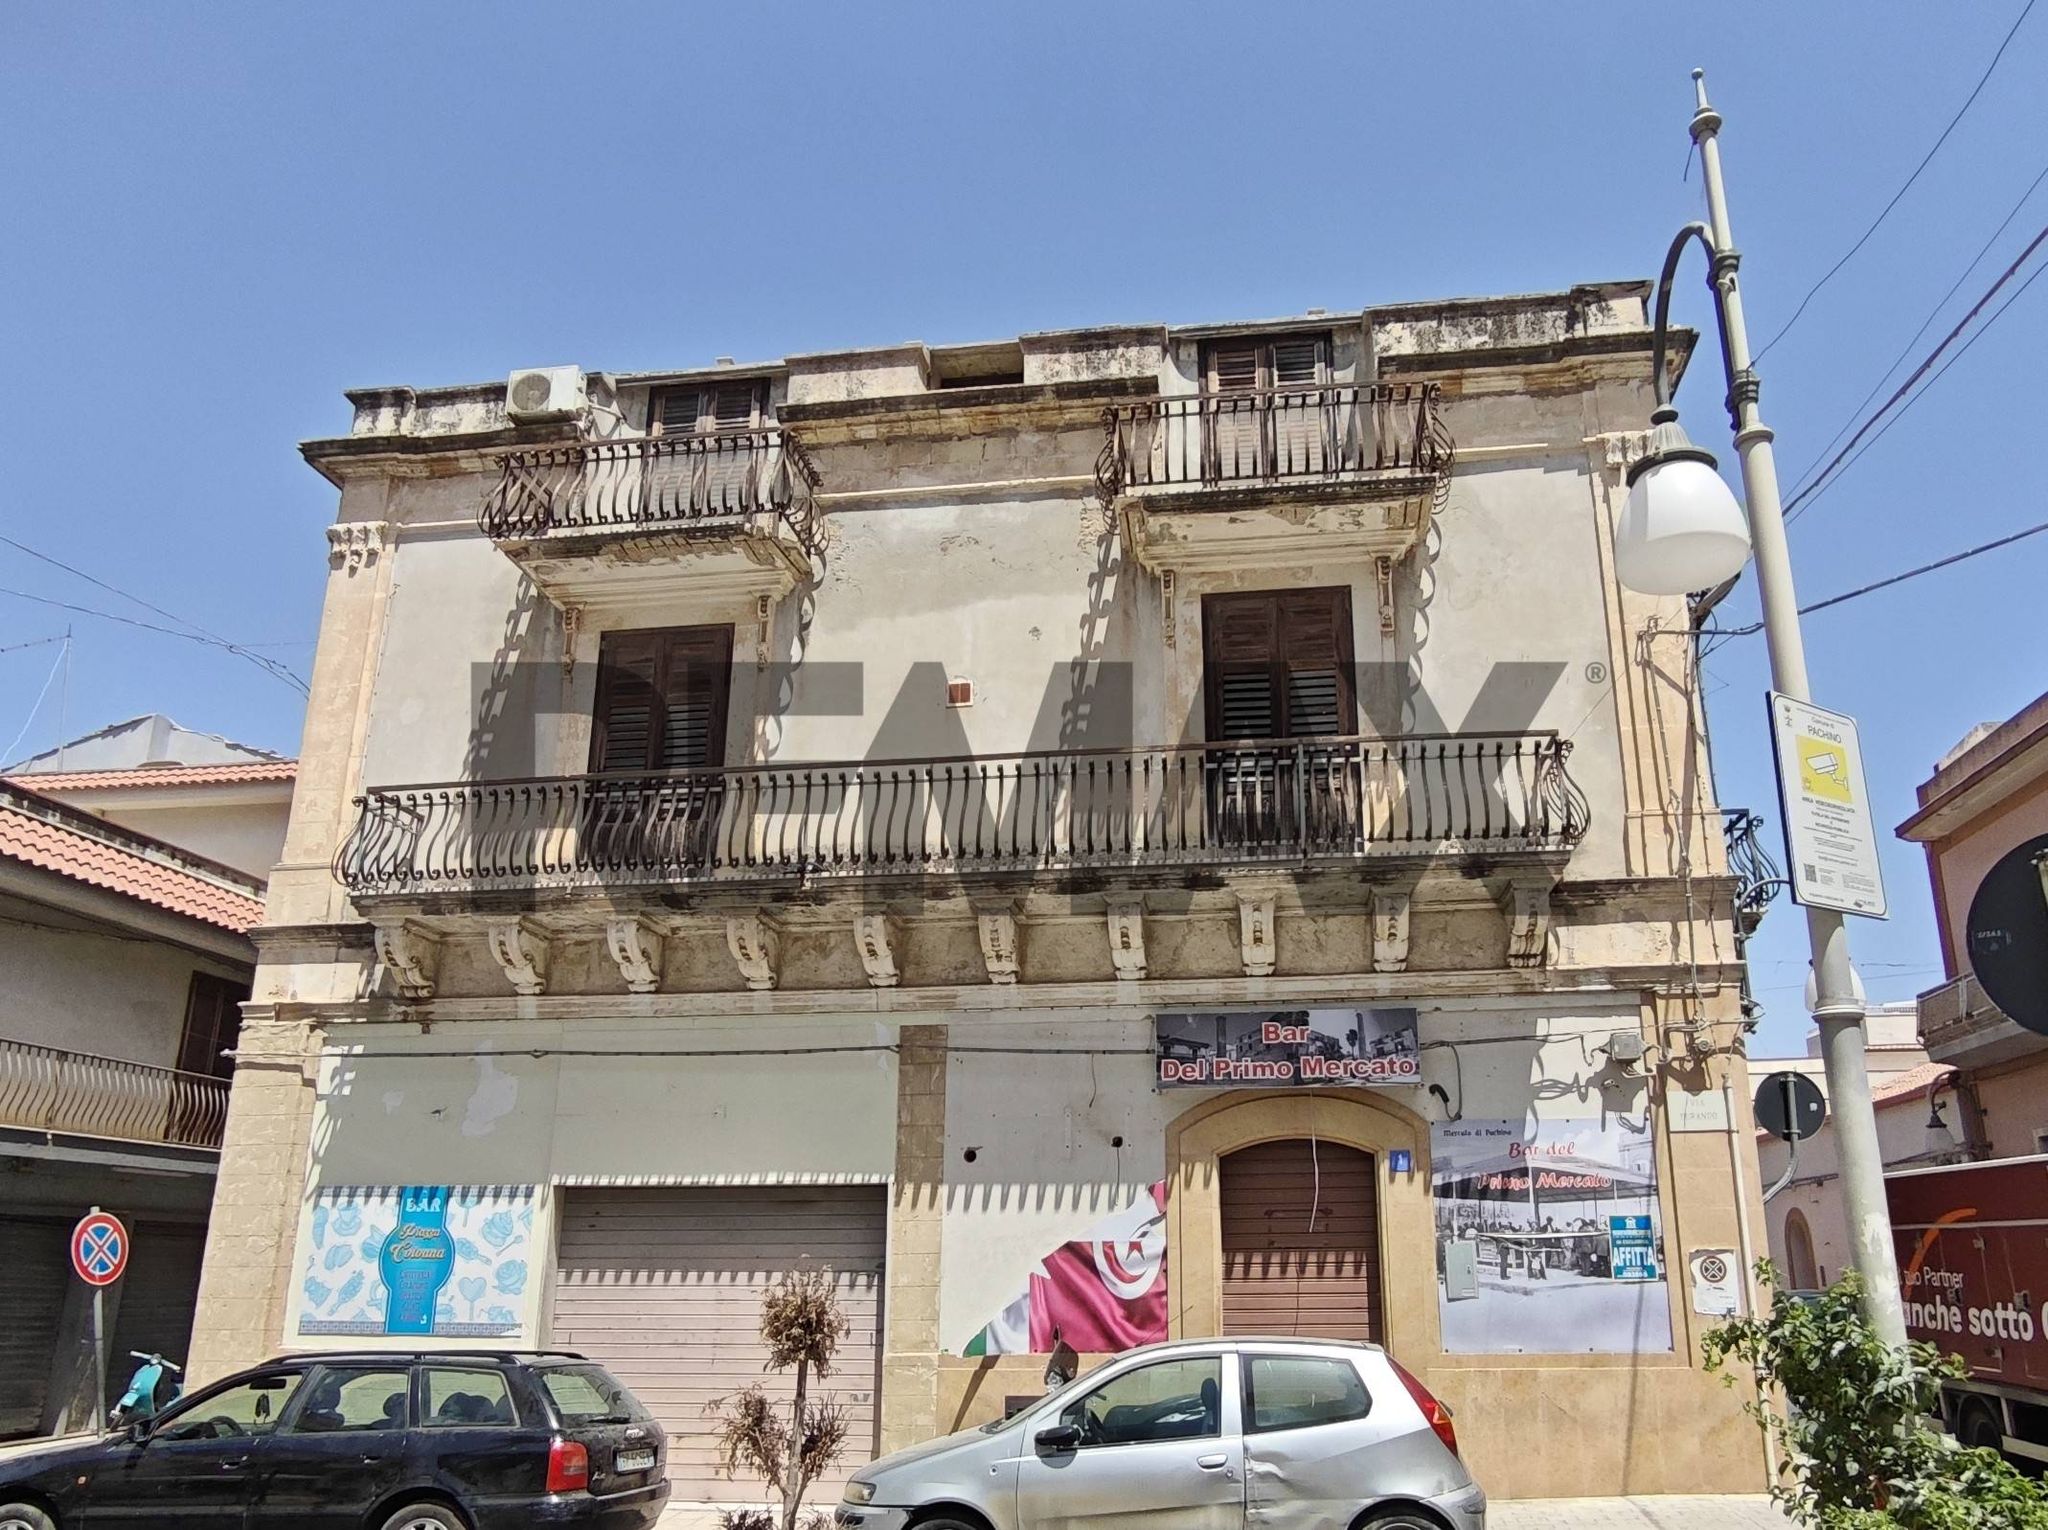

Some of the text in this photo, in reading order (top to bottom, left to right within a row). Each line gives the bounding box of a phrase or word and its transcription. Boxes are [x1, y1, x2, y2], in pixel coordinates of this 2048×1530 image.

[1807, 724, 1842, 744] PACHINO
[1261, 1021, 1311, 1044] Bar
[1160, 1055, 1417, 1081] Del Primo Mercato
[1508, 1141, 1575, 1159] Bar del
[1477, 1171, 1613, 1190] Primo Mercato
[405, 1197, 441, 1212] BAR
[1613, 1246, 1656, 1267] AFFITTA
[1923, 1266, 1964, 1289] Partner
[1967, 1301, 2035, 1342] sotto
